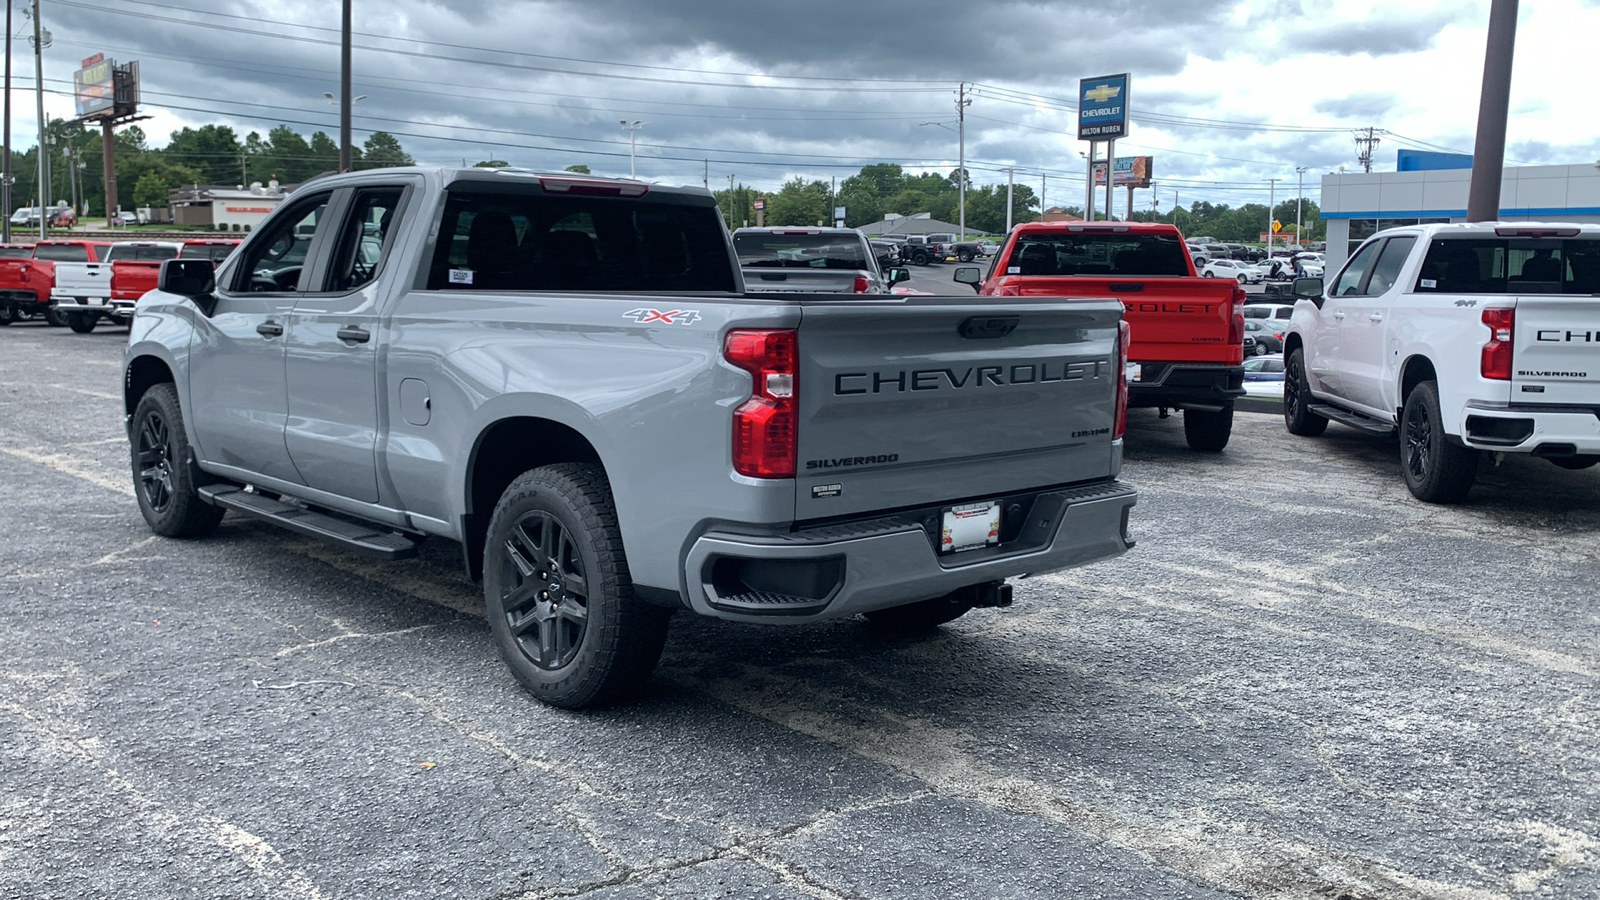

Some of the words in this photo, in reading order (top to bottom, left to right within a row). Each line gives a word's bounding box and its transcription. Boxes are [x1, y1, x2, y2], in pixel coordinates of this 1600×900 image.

[1082, 107, 1120, 117] CHEVROLET
[1081, 127, 1101, 135] MILTON
[1102, 125, 1120, 133] RUBEN
[1537, 330, 1600, 342] CH
[834, 360, 1107, 396] CHEVROLET
[806, 453, 899, 469] SILVERADO
